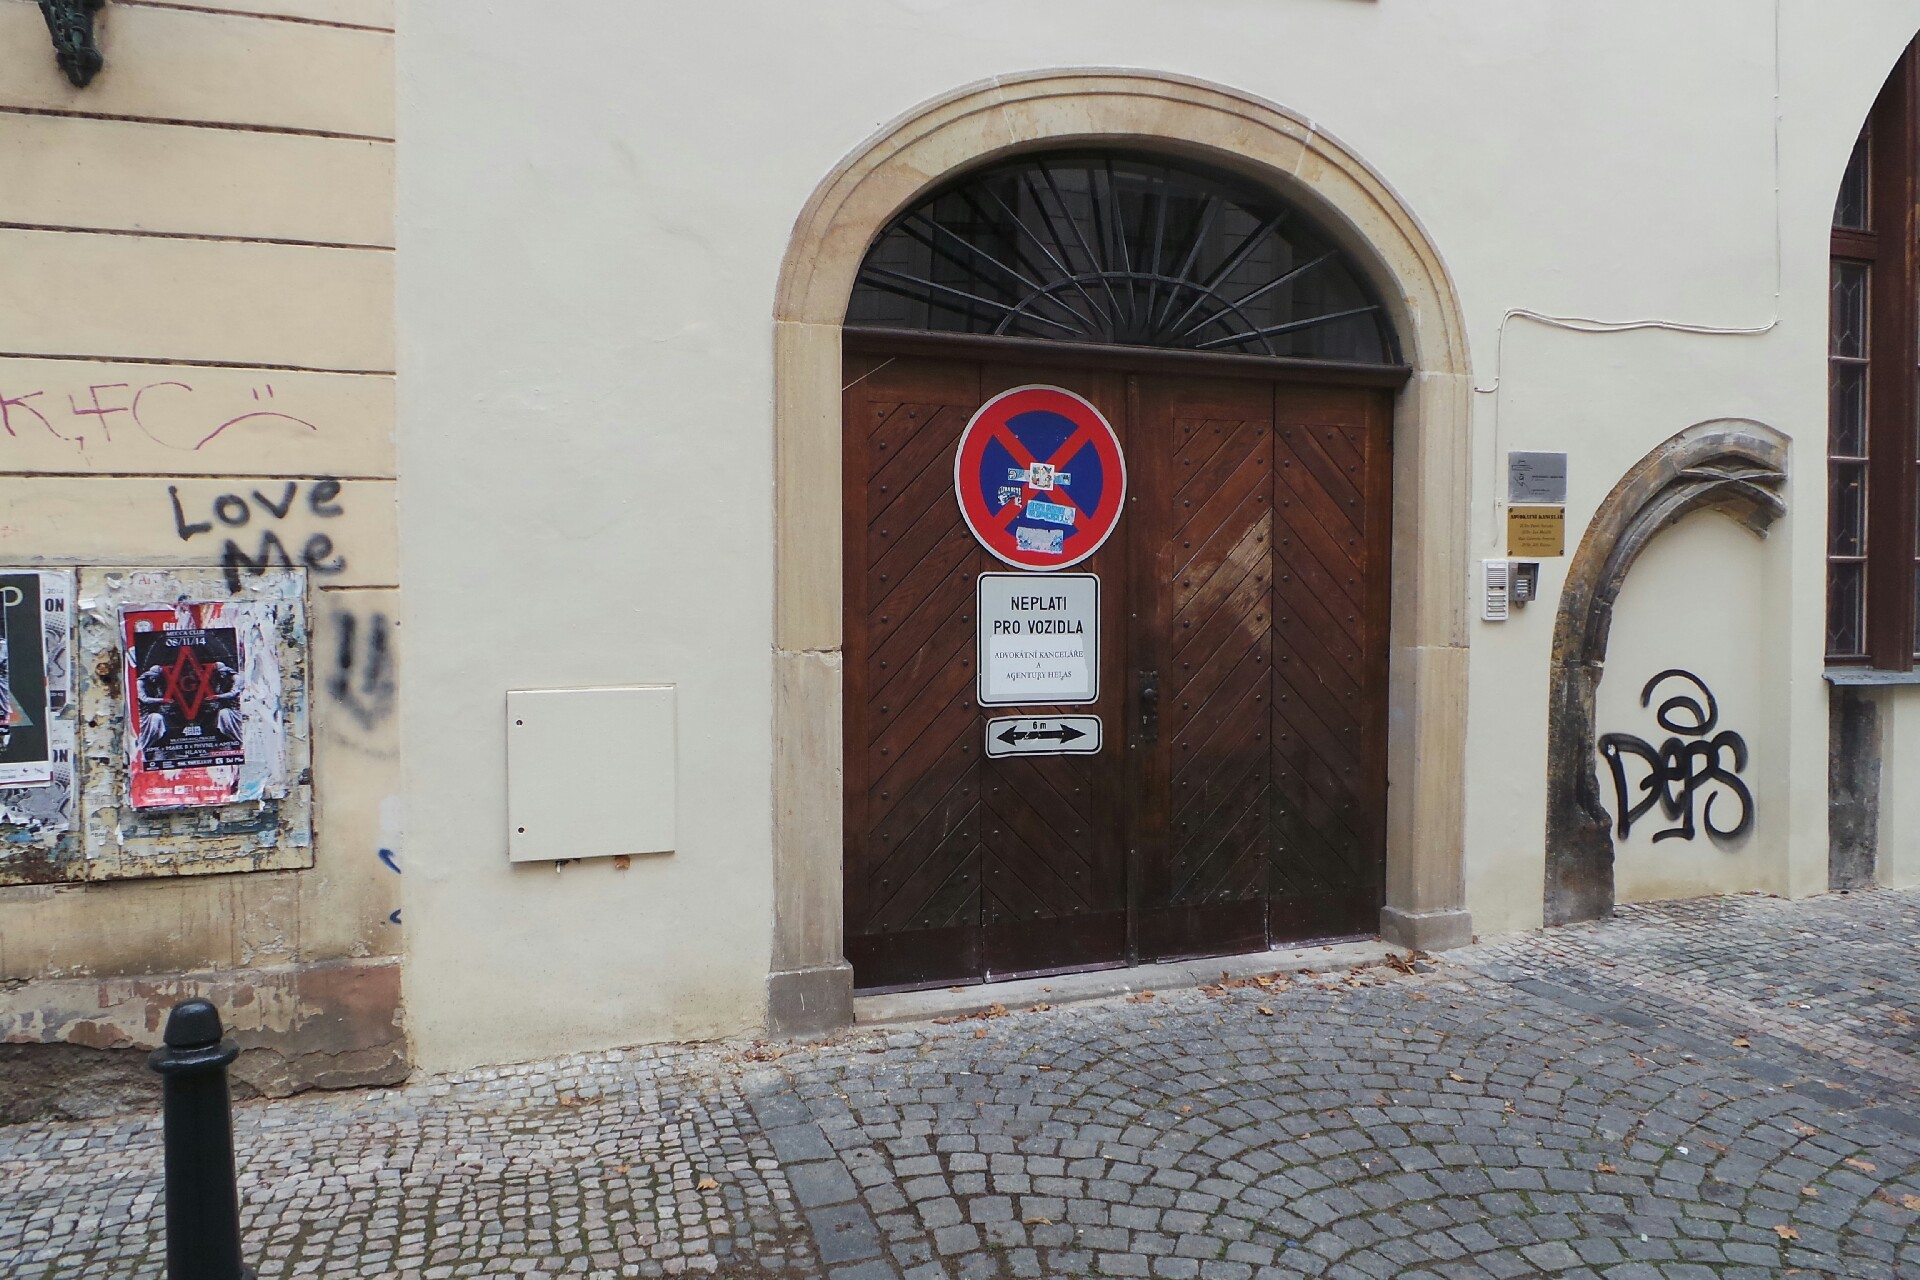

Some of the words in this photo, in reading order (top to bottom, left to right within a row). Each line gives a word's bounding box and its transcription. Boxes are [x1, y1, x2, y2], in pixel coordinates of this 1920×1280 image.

[220, 531, 347, 594] Me
[993, 620, 1021, 634] PRO
[1028, 619, 1084, 634] VOZIDLA
[165, 637, 206, 647] 08/11/14
[1006, 672, 1046, 680] AGENTURY
[1048, 671, 1072, 679] HELAS
[1032, 721, 1038, 730] 6
